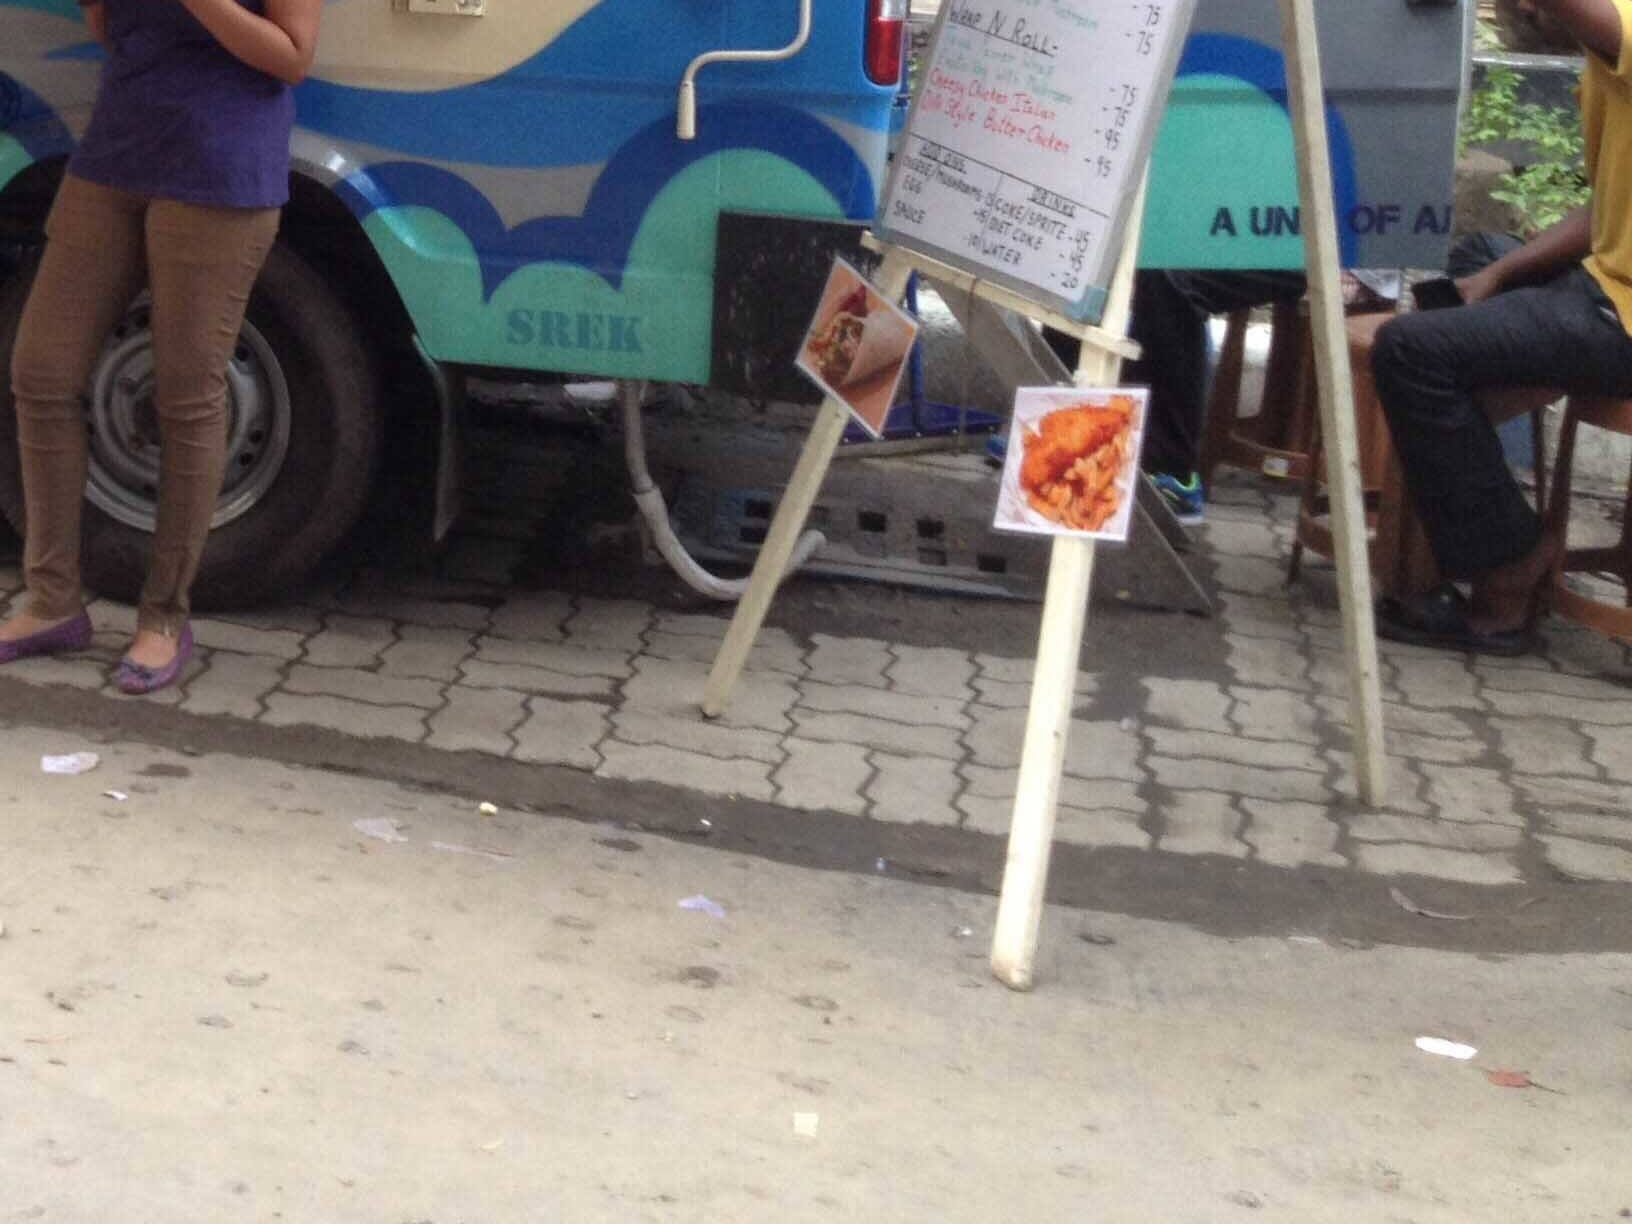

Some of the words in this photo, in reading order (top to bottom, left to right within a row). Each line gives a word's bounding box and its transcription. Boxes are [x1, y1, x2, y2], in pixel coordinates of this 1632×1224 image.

[987, 9, 1008, 36] N
[1209, 205, 1238, 237] A
[1348, 204, 1402, 236] OF
[506, 309, 643, 353] SREK
